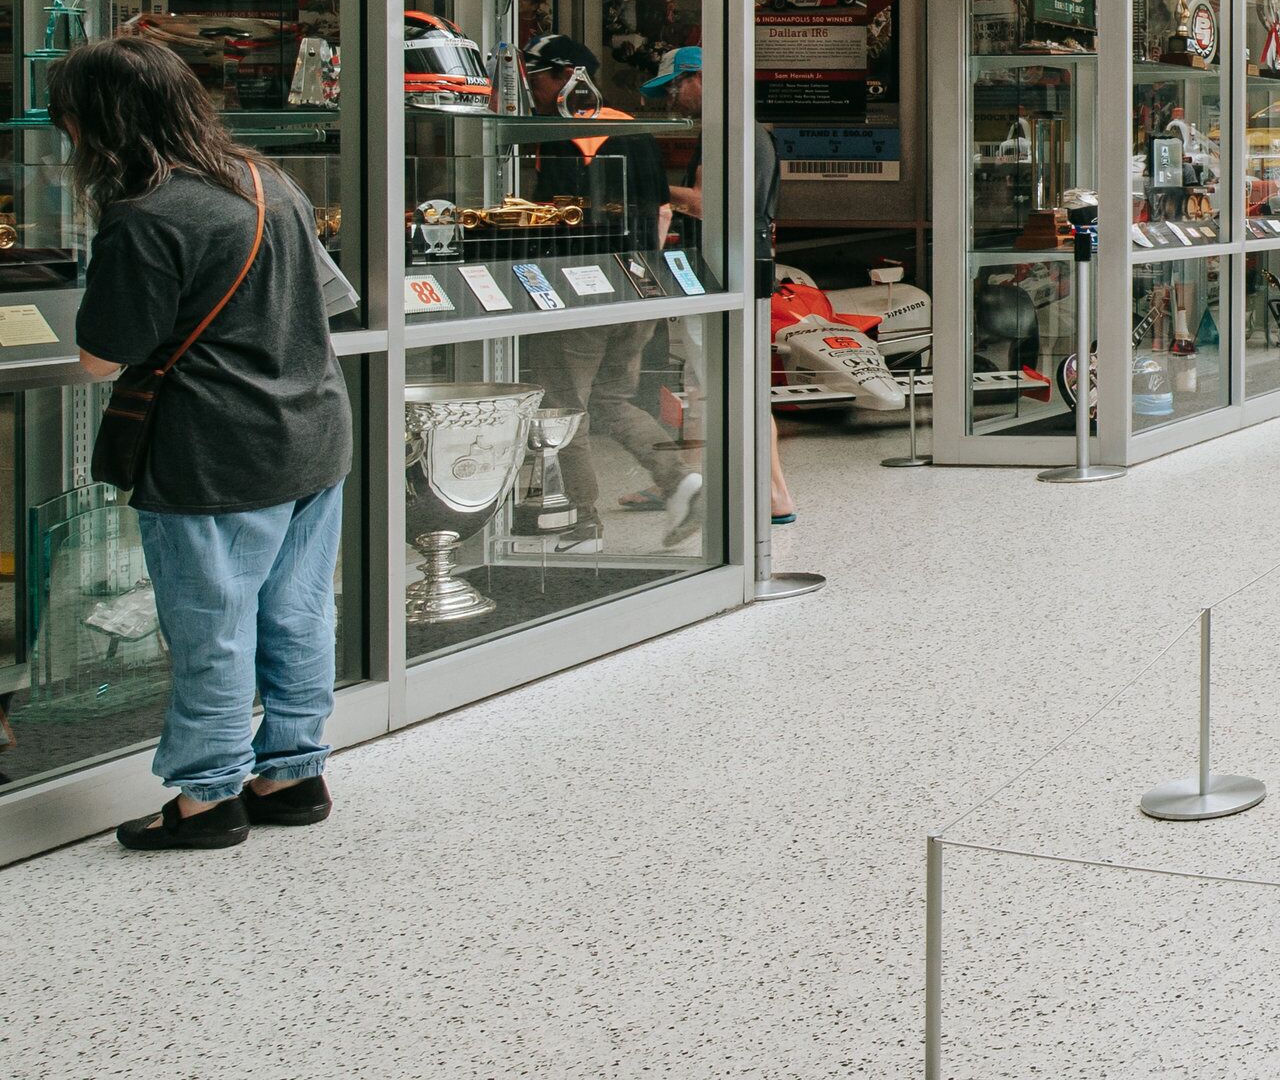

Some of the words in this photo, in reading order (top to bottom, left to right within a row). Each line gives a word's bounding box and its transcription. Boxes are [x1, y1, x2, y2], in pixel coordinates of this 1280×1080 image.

[769, 28, 808, 38] Dallara
[811, 28, 829, 38] IR6
[799, 130, 830, 138] STAND
[410, 281, 442, 305] 88
[539, 293, 559, 309] 15
[884, 300, 926, 319] Firestone
